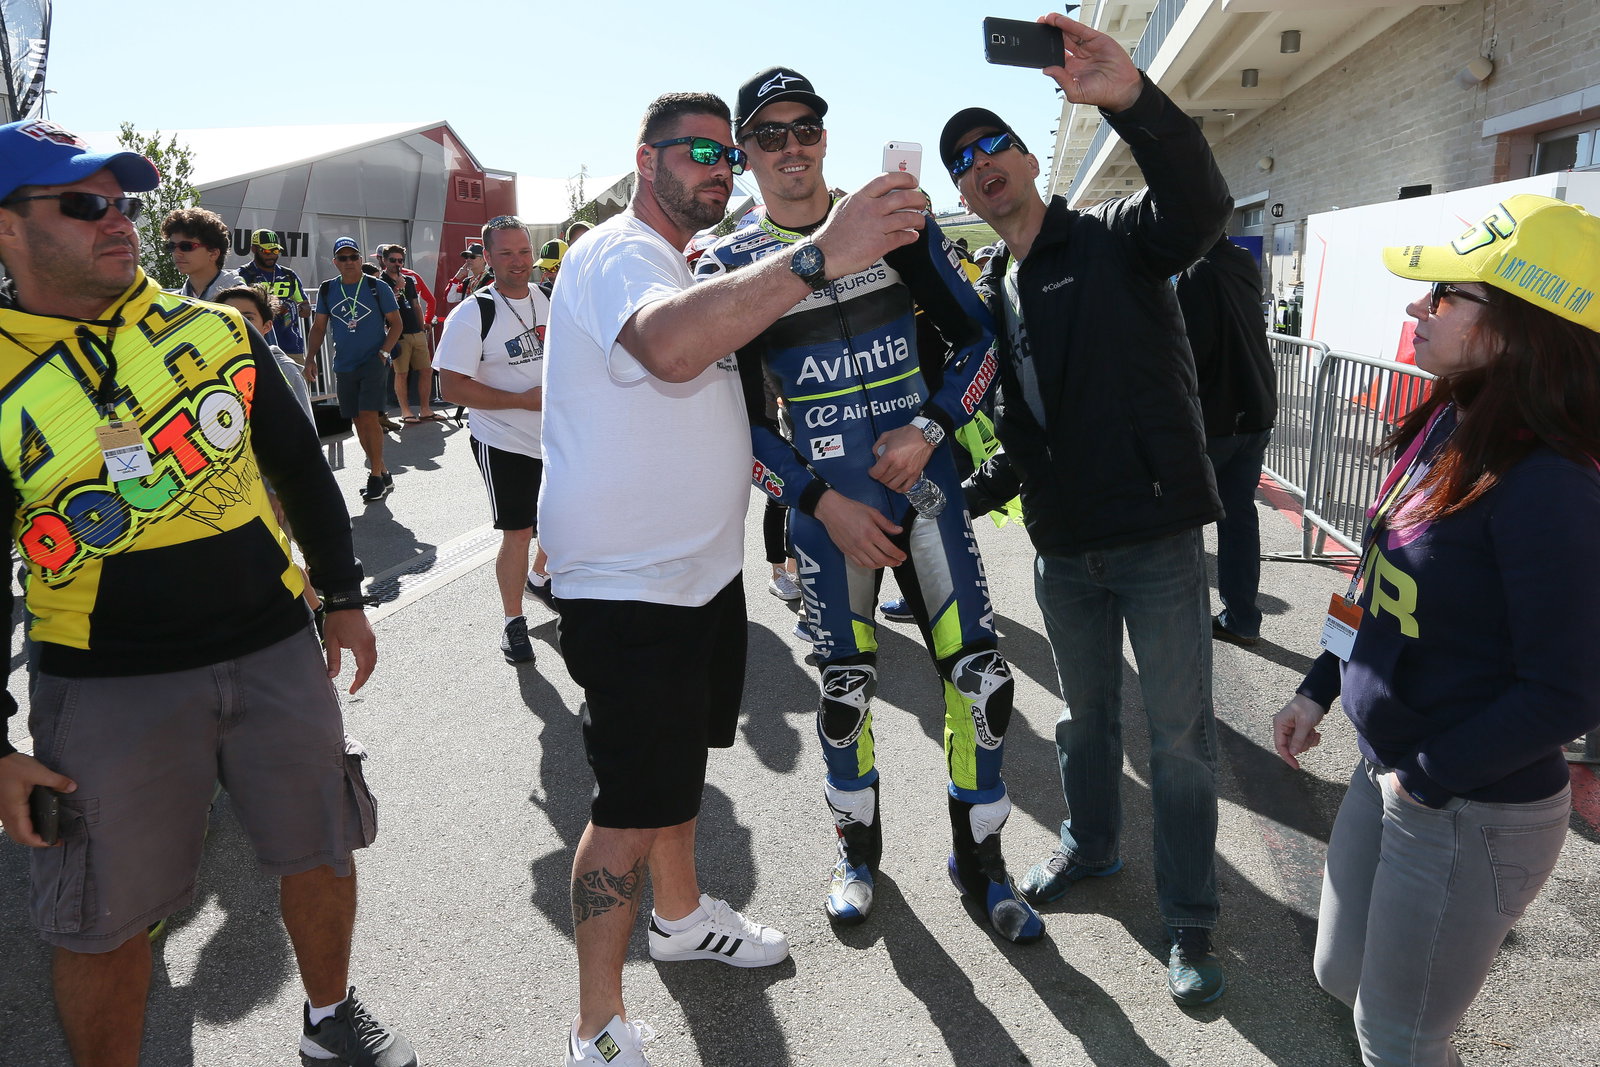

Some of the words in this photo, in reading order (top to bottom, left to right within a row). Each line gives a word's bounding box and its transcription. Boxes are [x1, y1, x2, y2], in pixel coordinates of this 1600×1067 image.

[228, 229, 309, 257] UATI
[1494, 253, 1509, 275] I
[1500, 257, 1524, 283] AM
[812, 269, 887, 299] SEGUROS
[1048, 276, 1074, 291] Columbia
[1518, 261, 1570, 305] OFFICIAL
[1563, 287, 1595, 314] FAN
[796, 335, 909, 385] Avintia
